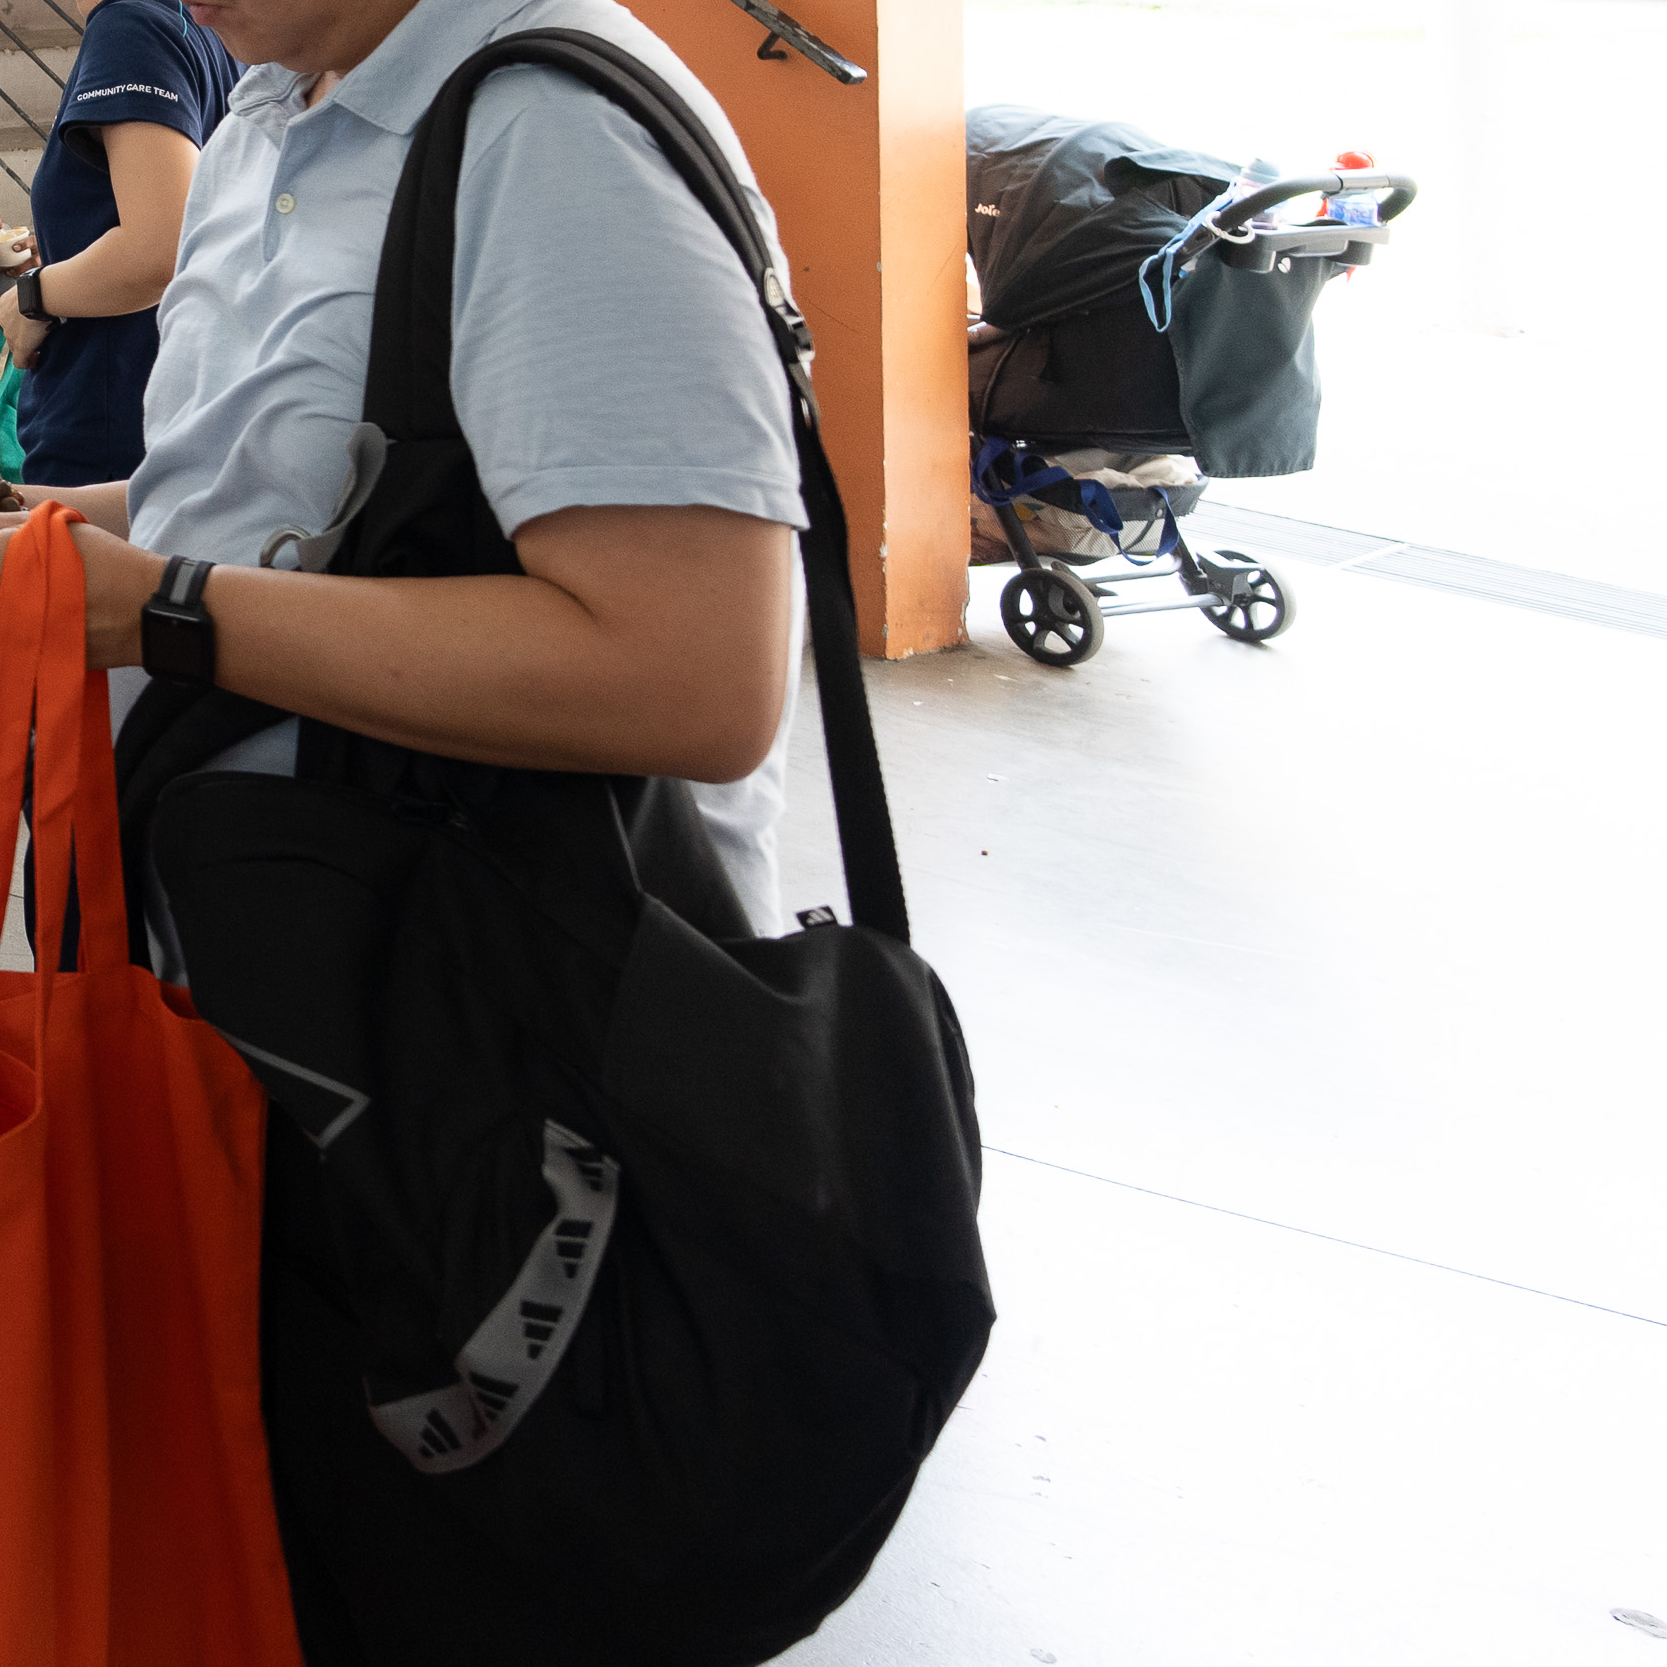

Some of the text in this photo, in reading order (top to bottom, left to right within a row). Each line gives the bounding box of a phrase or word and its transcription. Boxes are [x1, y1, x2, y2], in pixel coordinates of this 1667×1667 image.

[77, 84, 178, 102] COMMUNITY CARE TEAM
[975, 203, 1000, 217] Joie
